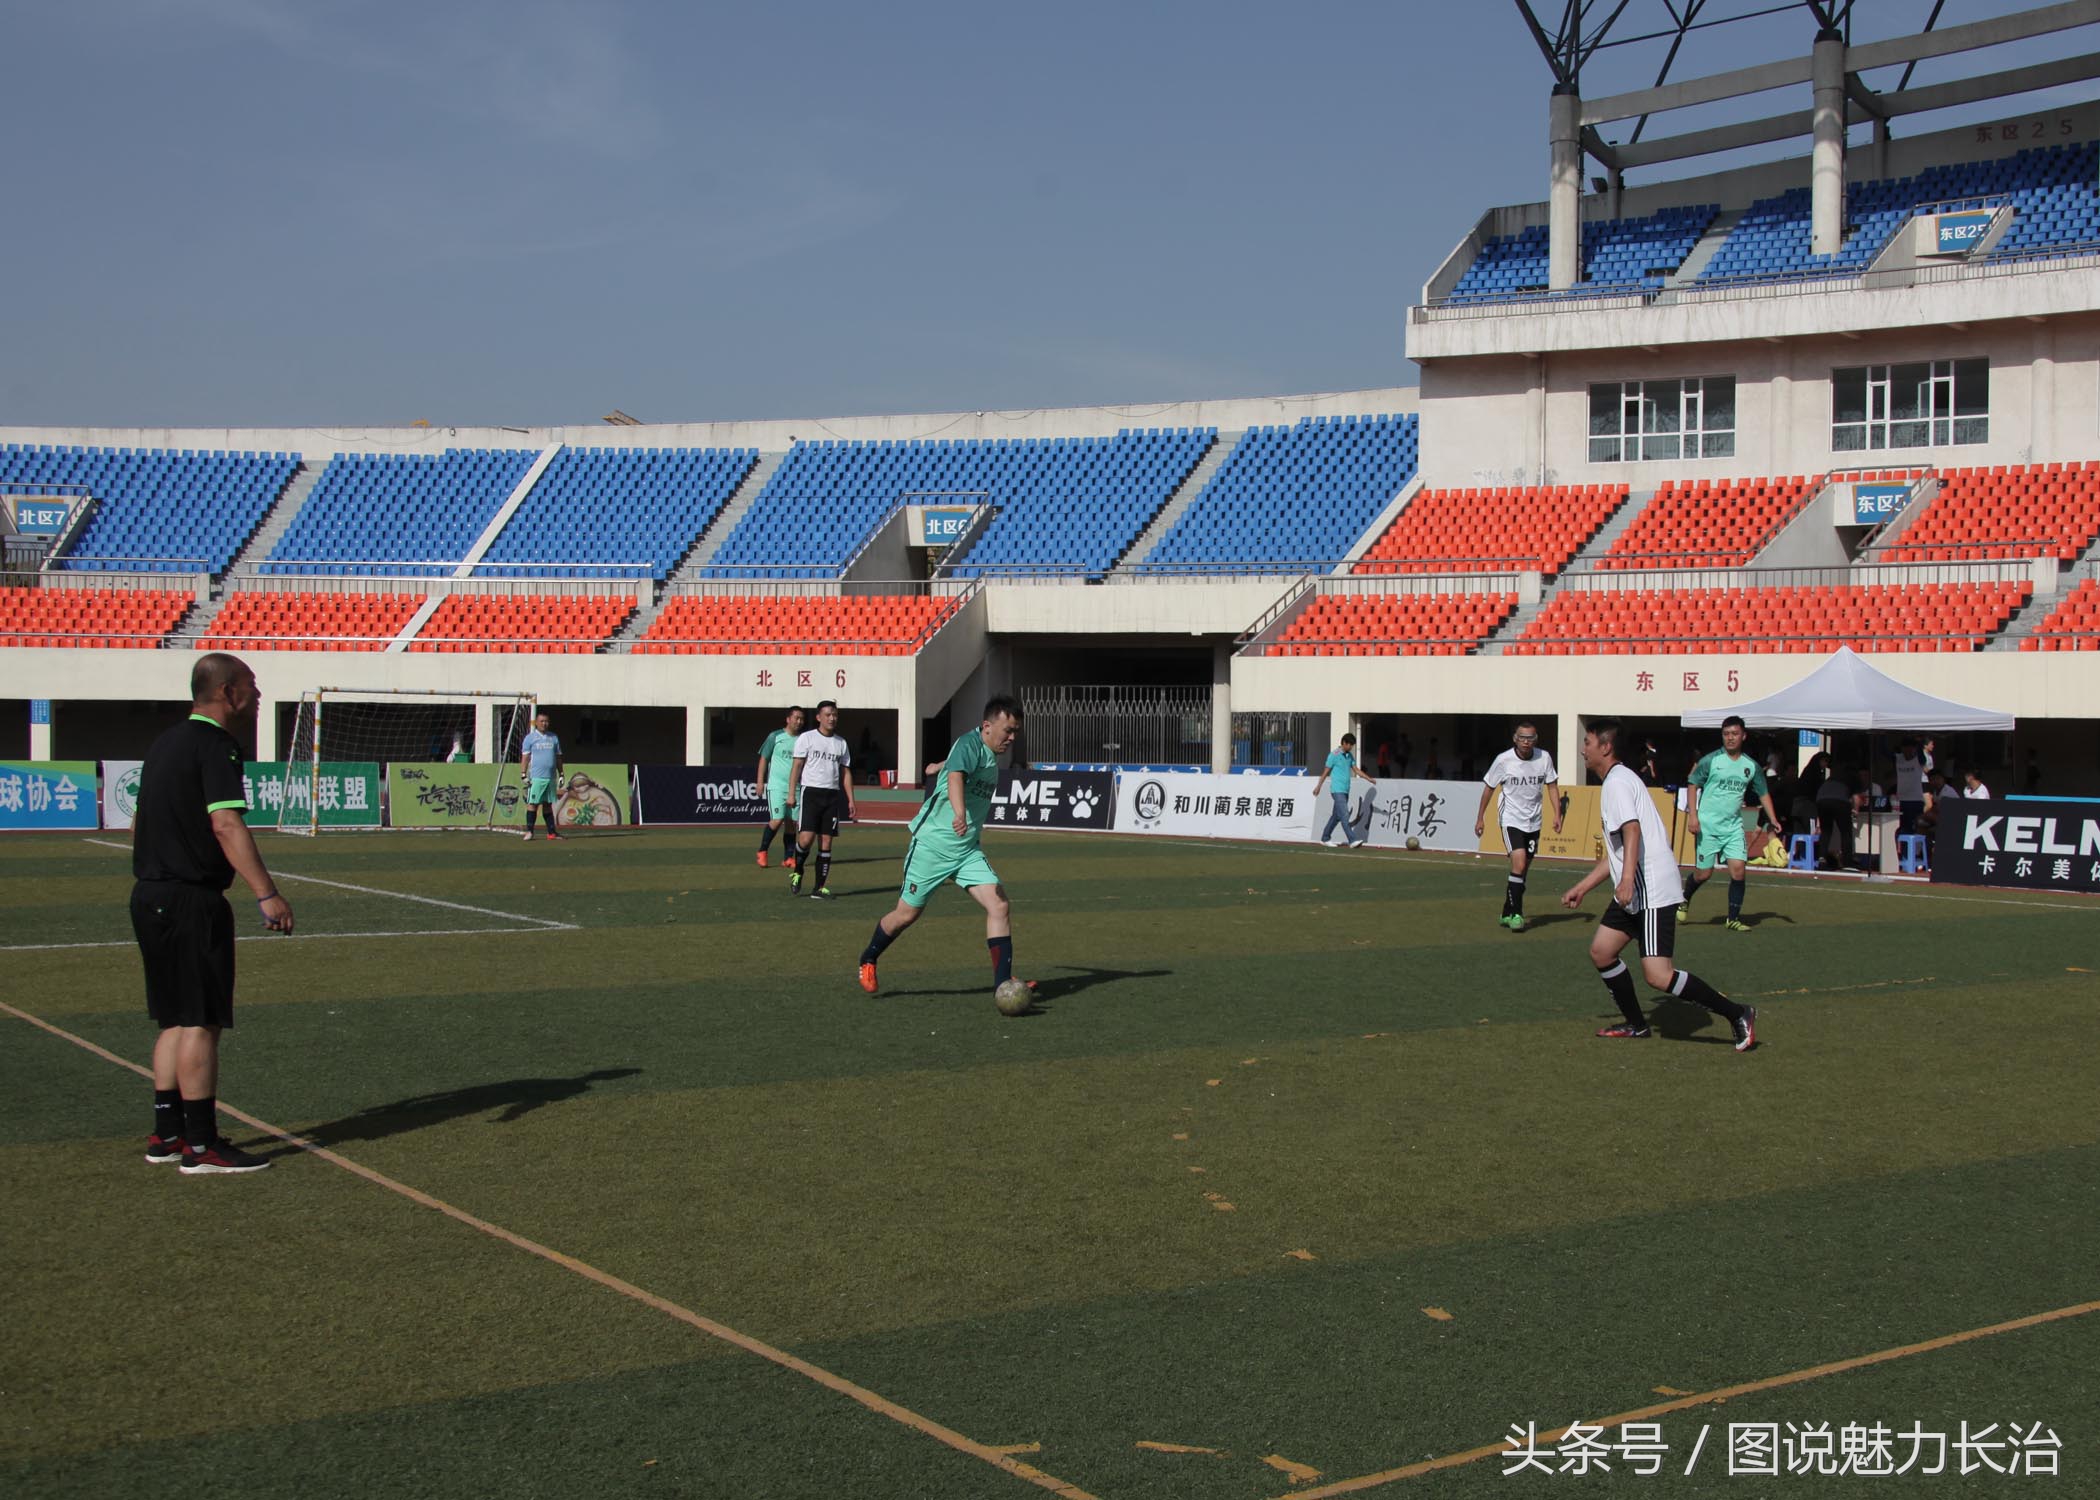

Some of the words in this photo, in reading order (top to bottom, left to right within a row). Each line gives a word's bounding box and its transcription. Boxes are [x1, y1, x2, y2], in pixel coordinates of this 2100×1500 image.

[1940, 223, 1988, 241] 东区25
[1857, 494, 1907, 514] 东区5
[19, 509, 66, 525] 北区7
[0, 774, 80, 812] 球协会
[696, 803, 710, 814] For
[712, 803, 728, 812] the
[729, 803, 749, 812] real
[750, 805, 770, 816] gam
[1528, 839, 1535, 853] 3
